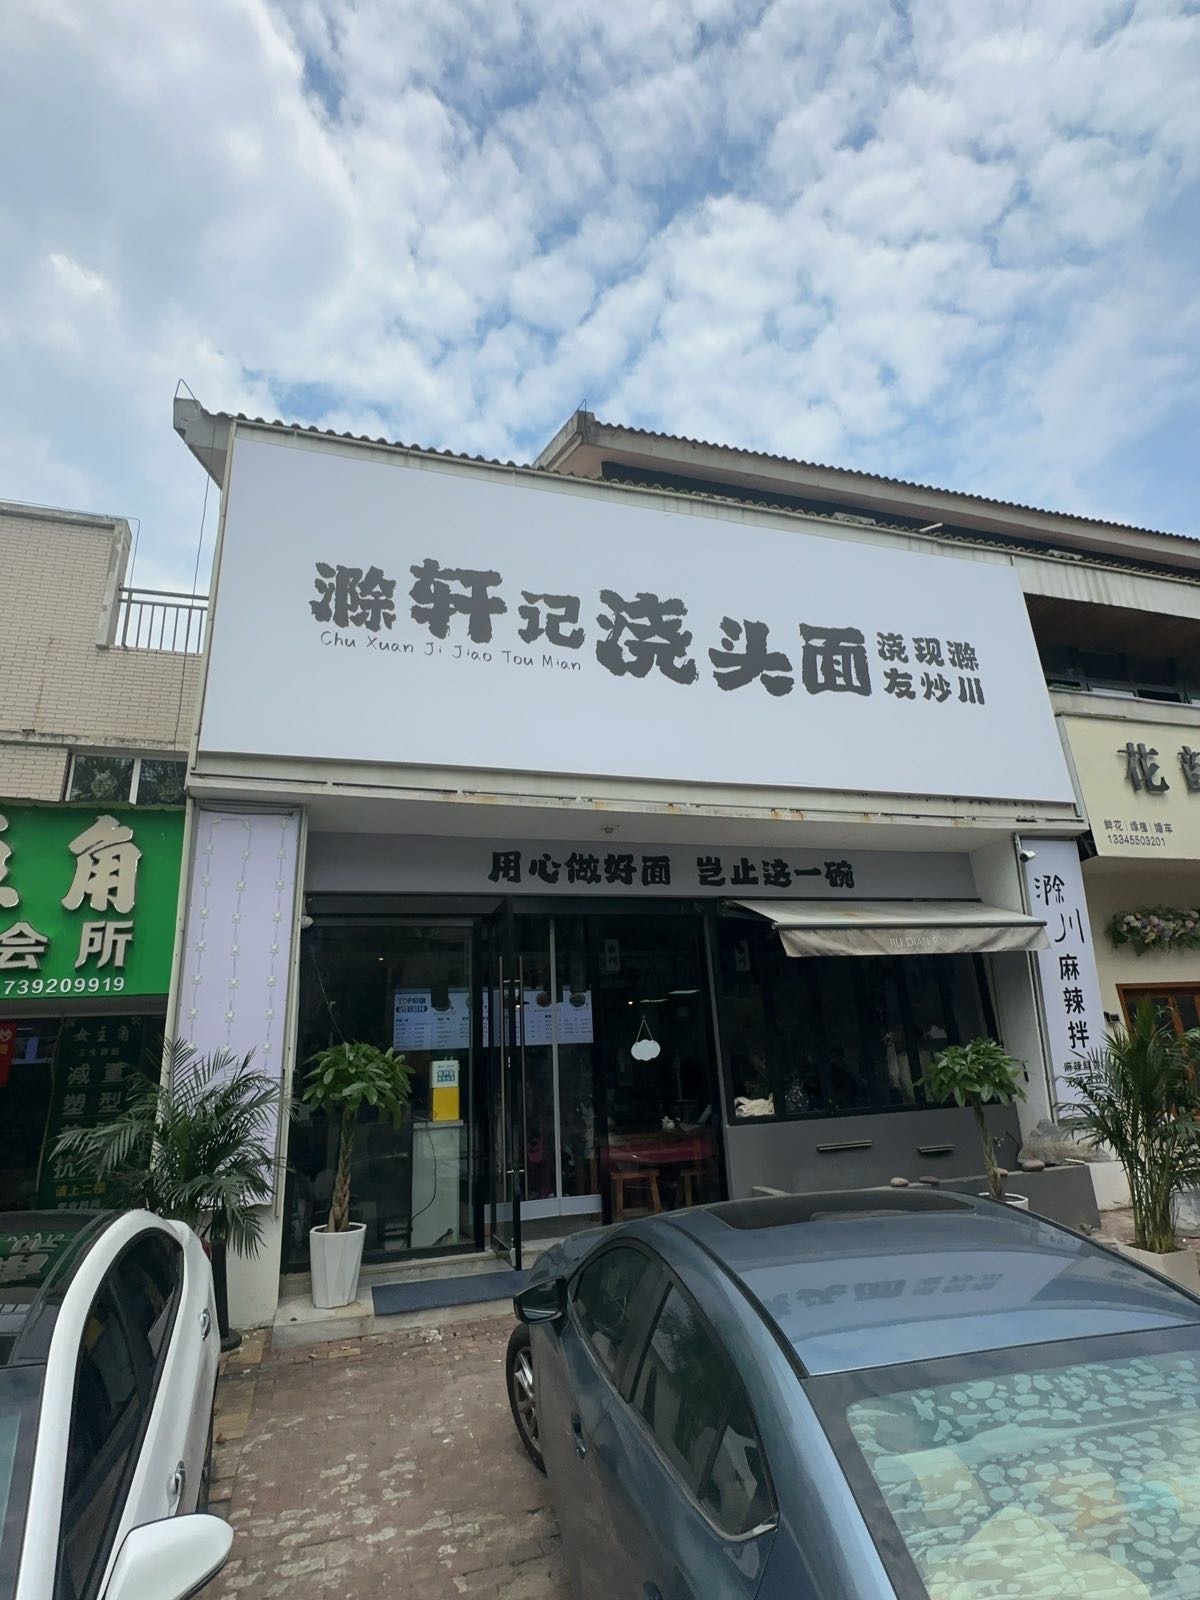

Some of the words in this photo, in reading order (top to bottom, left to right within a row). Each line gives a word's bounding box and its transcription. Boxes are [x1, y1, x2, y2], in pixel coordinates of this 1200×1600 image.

[309, 558, 873, 697] 滁轩记浇头面
[320, 630, 358, 648] Chu
[366, 634, 414, 654] Xuan
[424, 641, 443, 656] Ji
[452, 643, 492, 662] Jiao
[501, 650, 534, 667] Tou
[542, 654, 582, 671] Mian
[0, 814, 142, 914] 角
[488, 850, 671, 887] 用心做好面
[696, 856, 854, 889] 岂止这一碗
[1107, 834, 1166, 847] 13345503201
[1034, 874, 1090, 1050] 滁川麻辣拌
